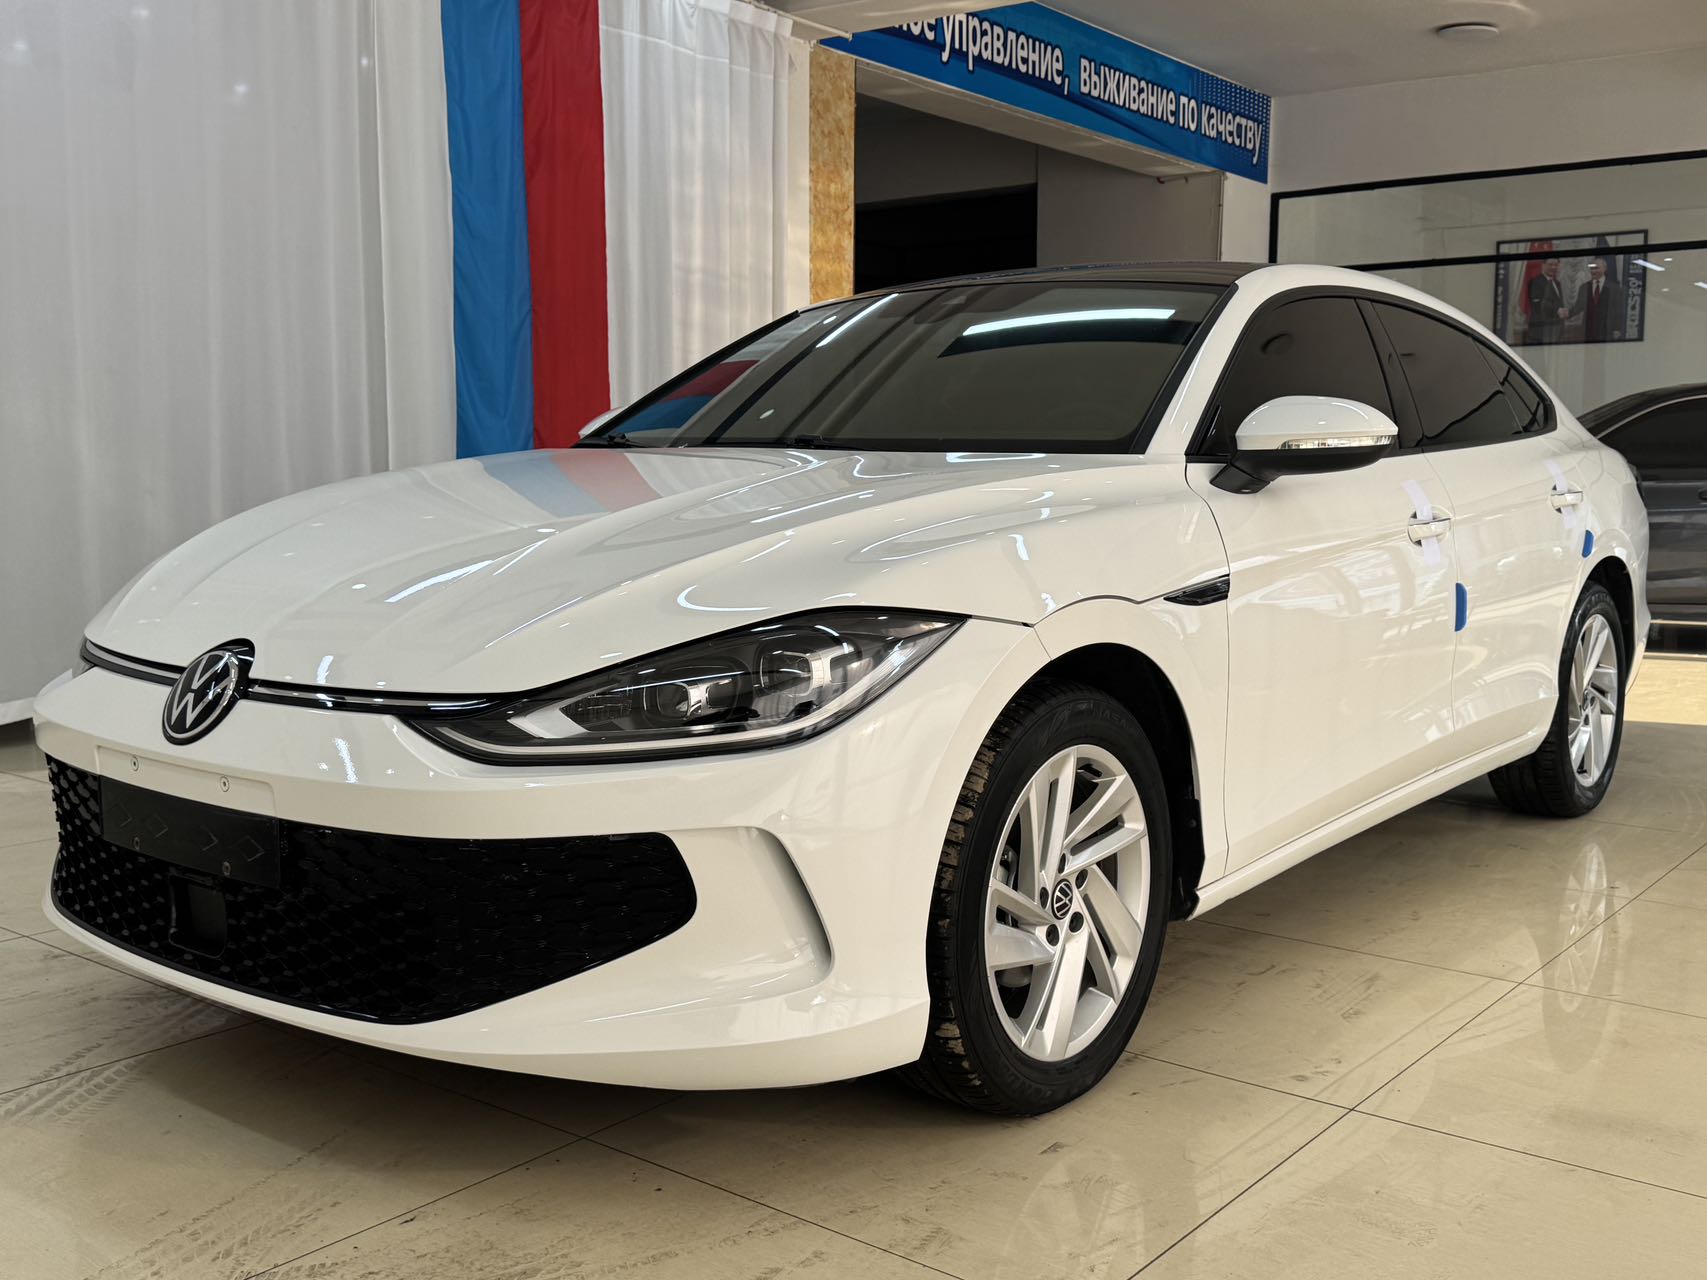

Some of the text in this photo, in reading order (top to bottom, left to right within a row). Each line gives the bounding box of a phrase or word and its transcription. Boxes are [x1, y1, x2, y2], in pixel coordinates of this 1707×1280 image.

[941, 13, 1262, 164] управление, выживание по качеству
